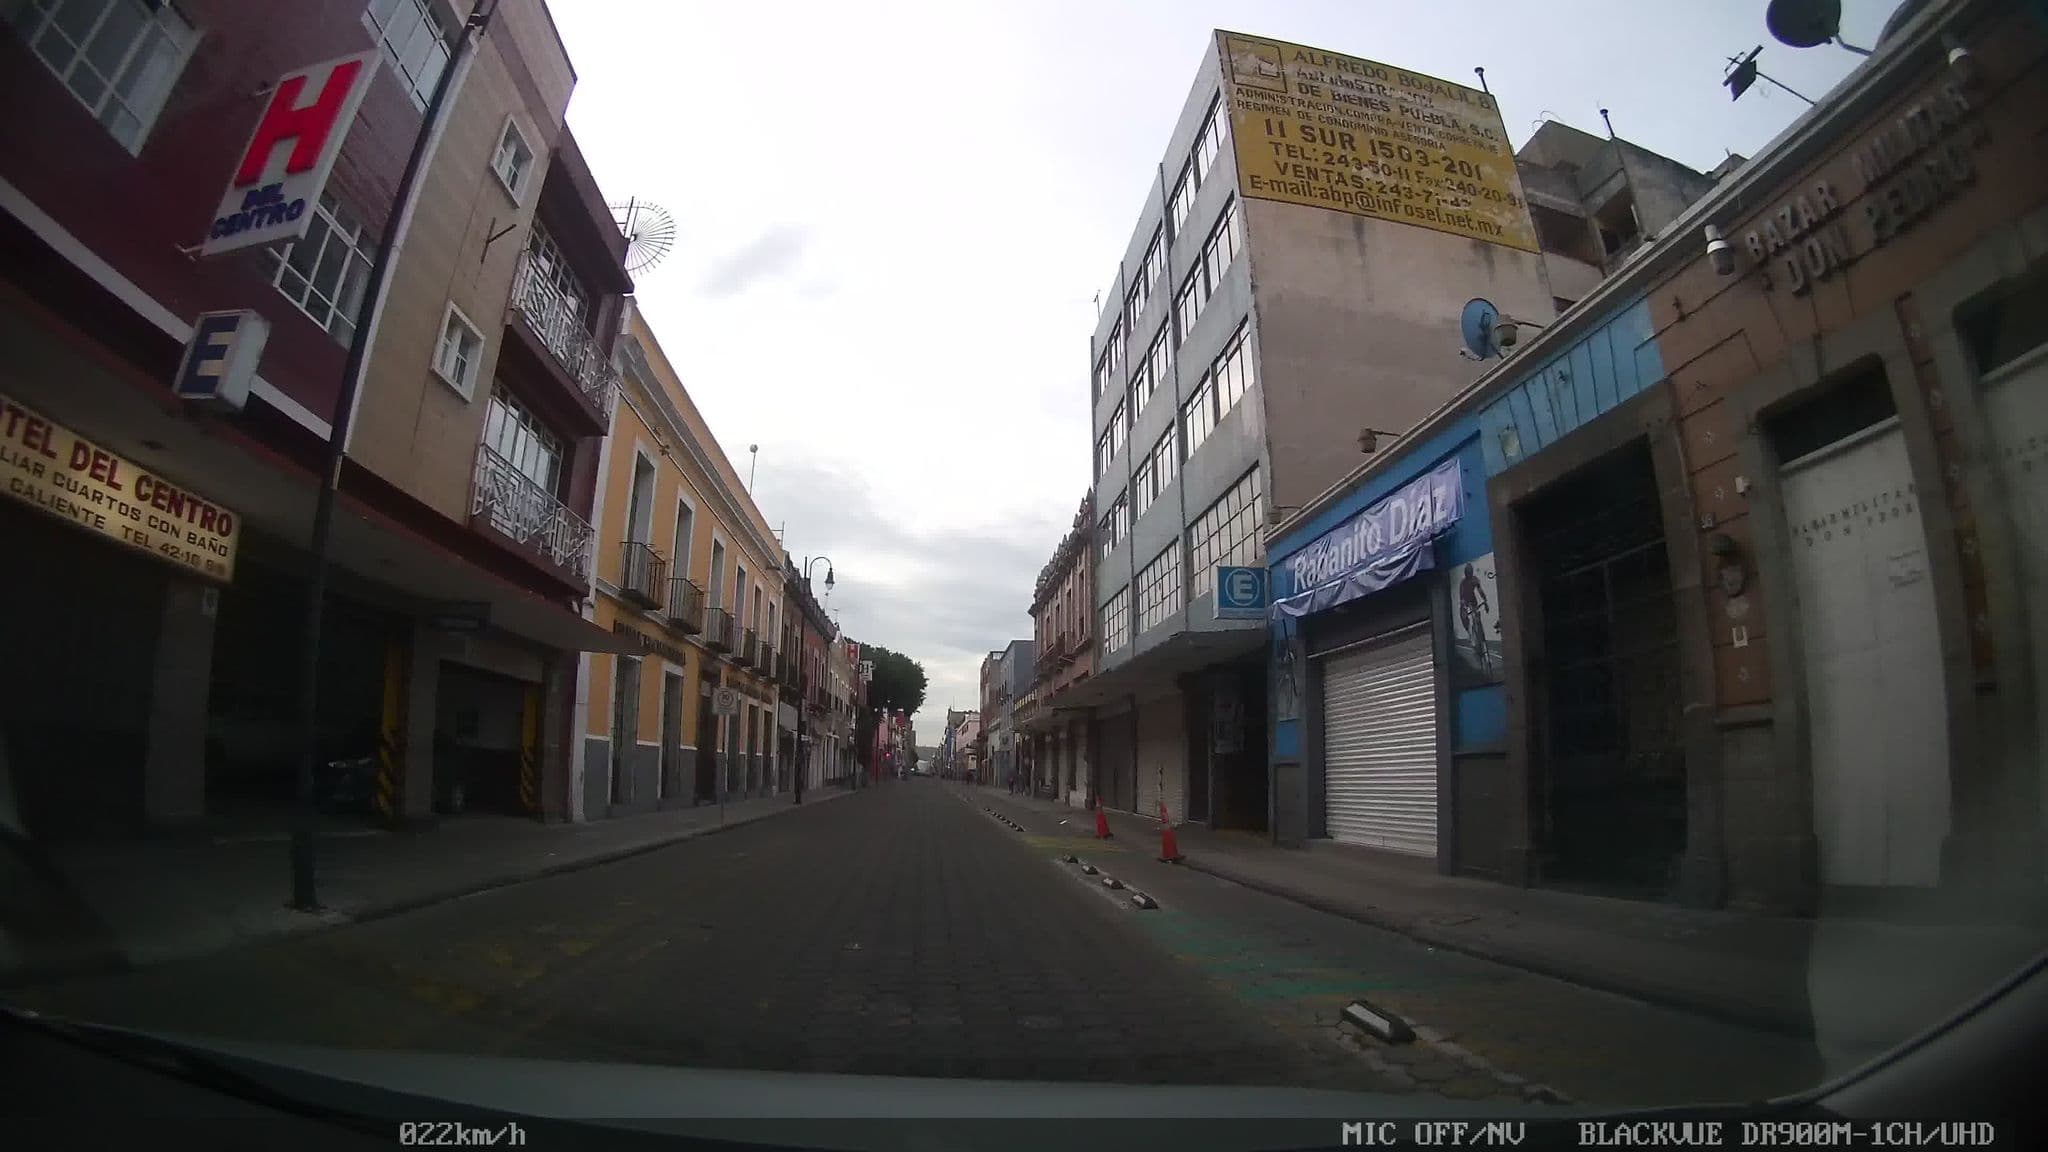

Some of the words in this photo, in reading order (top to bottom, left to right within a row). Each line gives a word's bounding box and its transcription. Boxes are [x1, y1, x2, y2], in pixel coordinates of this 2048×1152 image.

[1294, 50, 1388, 81] ALFREDO
[1298, 82, 1321, 97] DE
[1331, 88, 1391, 112] BIENES
[234, 60, 362, 187] H
[1236, 99, 1291, 117] REGIMEN
[1297, 110, 1313, 122] DE
[1318, 114, 1388, 137] CONDOMINIO
[1393, 130, 1447, 151] ASESORIA
[1300, 124, 1356, 152] SUR
[1369, 138, 1482, 181] 1503-201
[210, 199, 306, 239] CENTRO
[241, 182, 284, 211] DEL
[1744, 178, 1840, 262] BAZAR
[179, 315, 240, 394] E
[0, 403, 57, 459] TEL
[69, 441, 122, 491] DEL
[135, 474, 233, 538] CENTRO
[10, 476, 107, 531] CALIENTE
[122, 524, 151, 549] TEL
[52, 470, 142, 522] CUARTOS
[148, 514, 181, 539] CON
[187, 531, 229, 558] BAÑO
[1233, 574, 1254, 600] E
[1293, 519, 1383, 593] Rabanito
